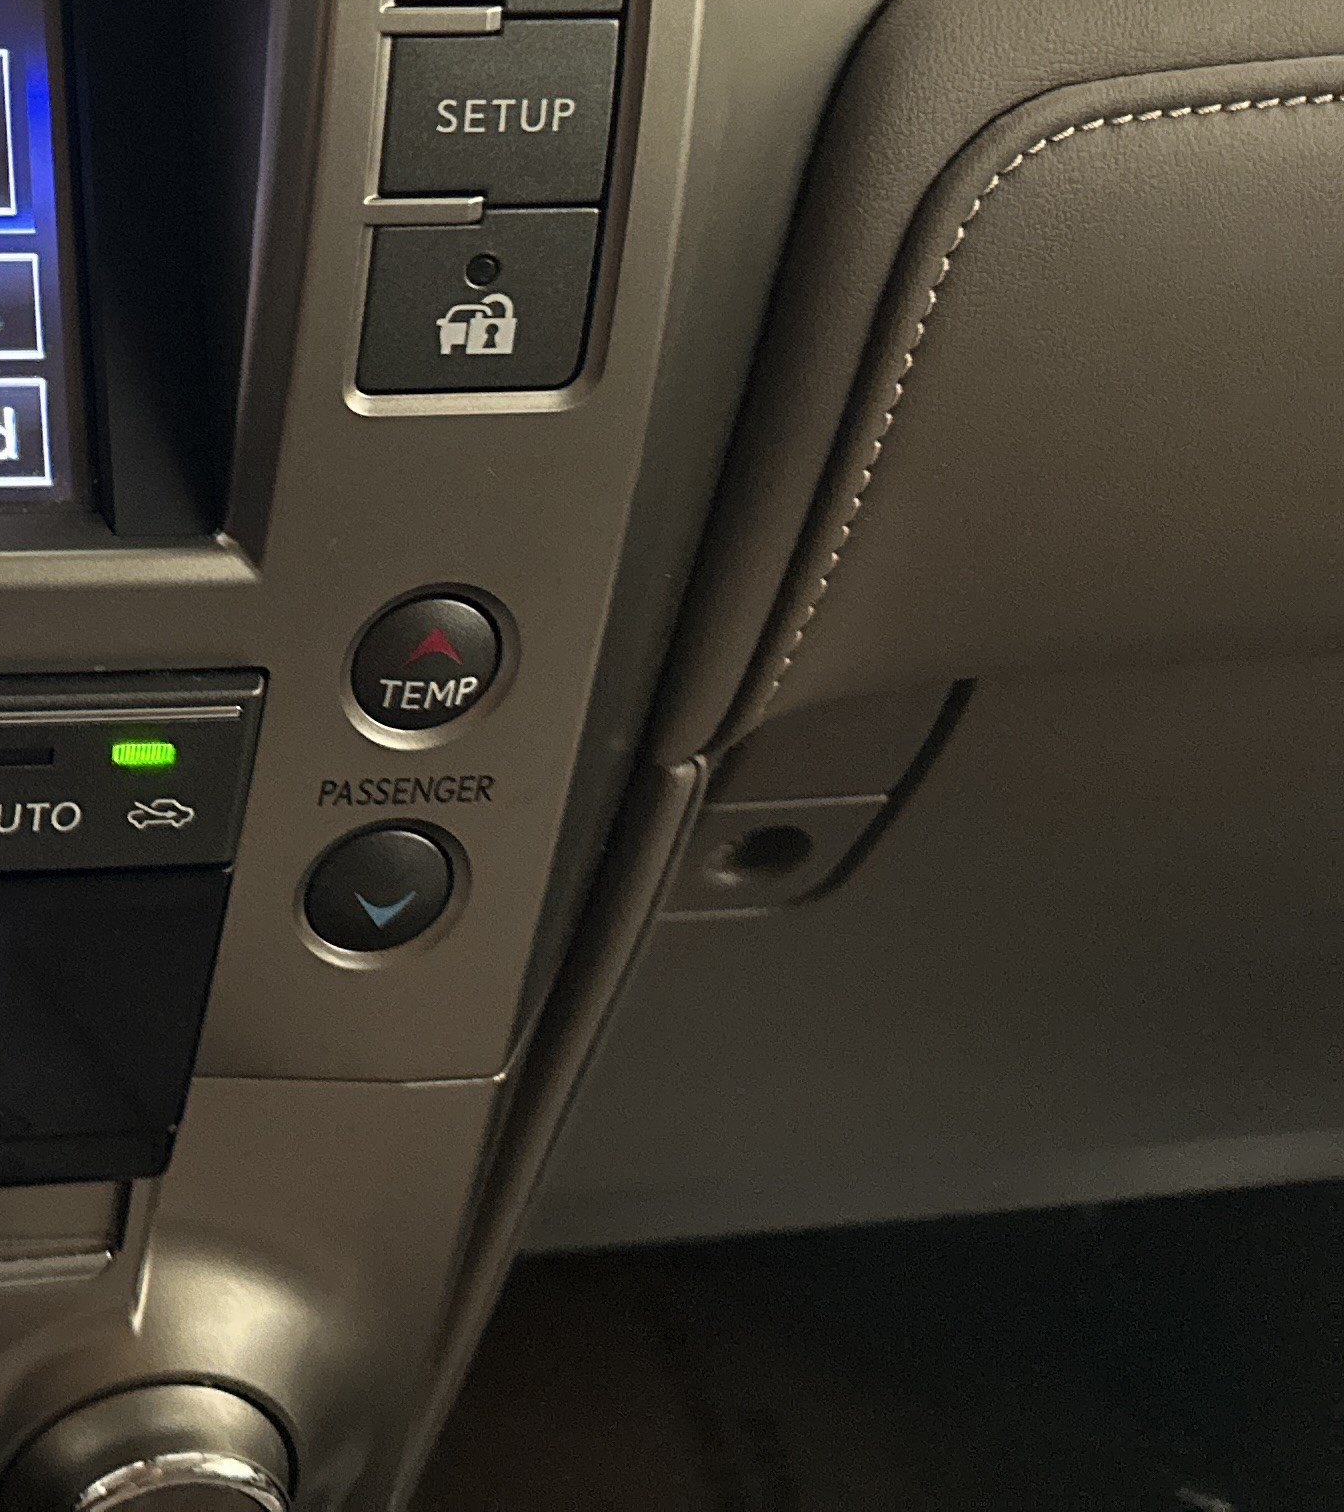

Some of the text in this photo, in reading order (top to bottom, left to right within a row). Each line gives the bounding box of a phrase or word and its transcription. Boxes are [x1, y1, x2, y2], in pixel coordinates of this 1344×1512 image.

[434, 97, 578, 134] SETUP
[379, 675, 479, 710] TEMP
[317, 774, 496, 807] PASSENGER
